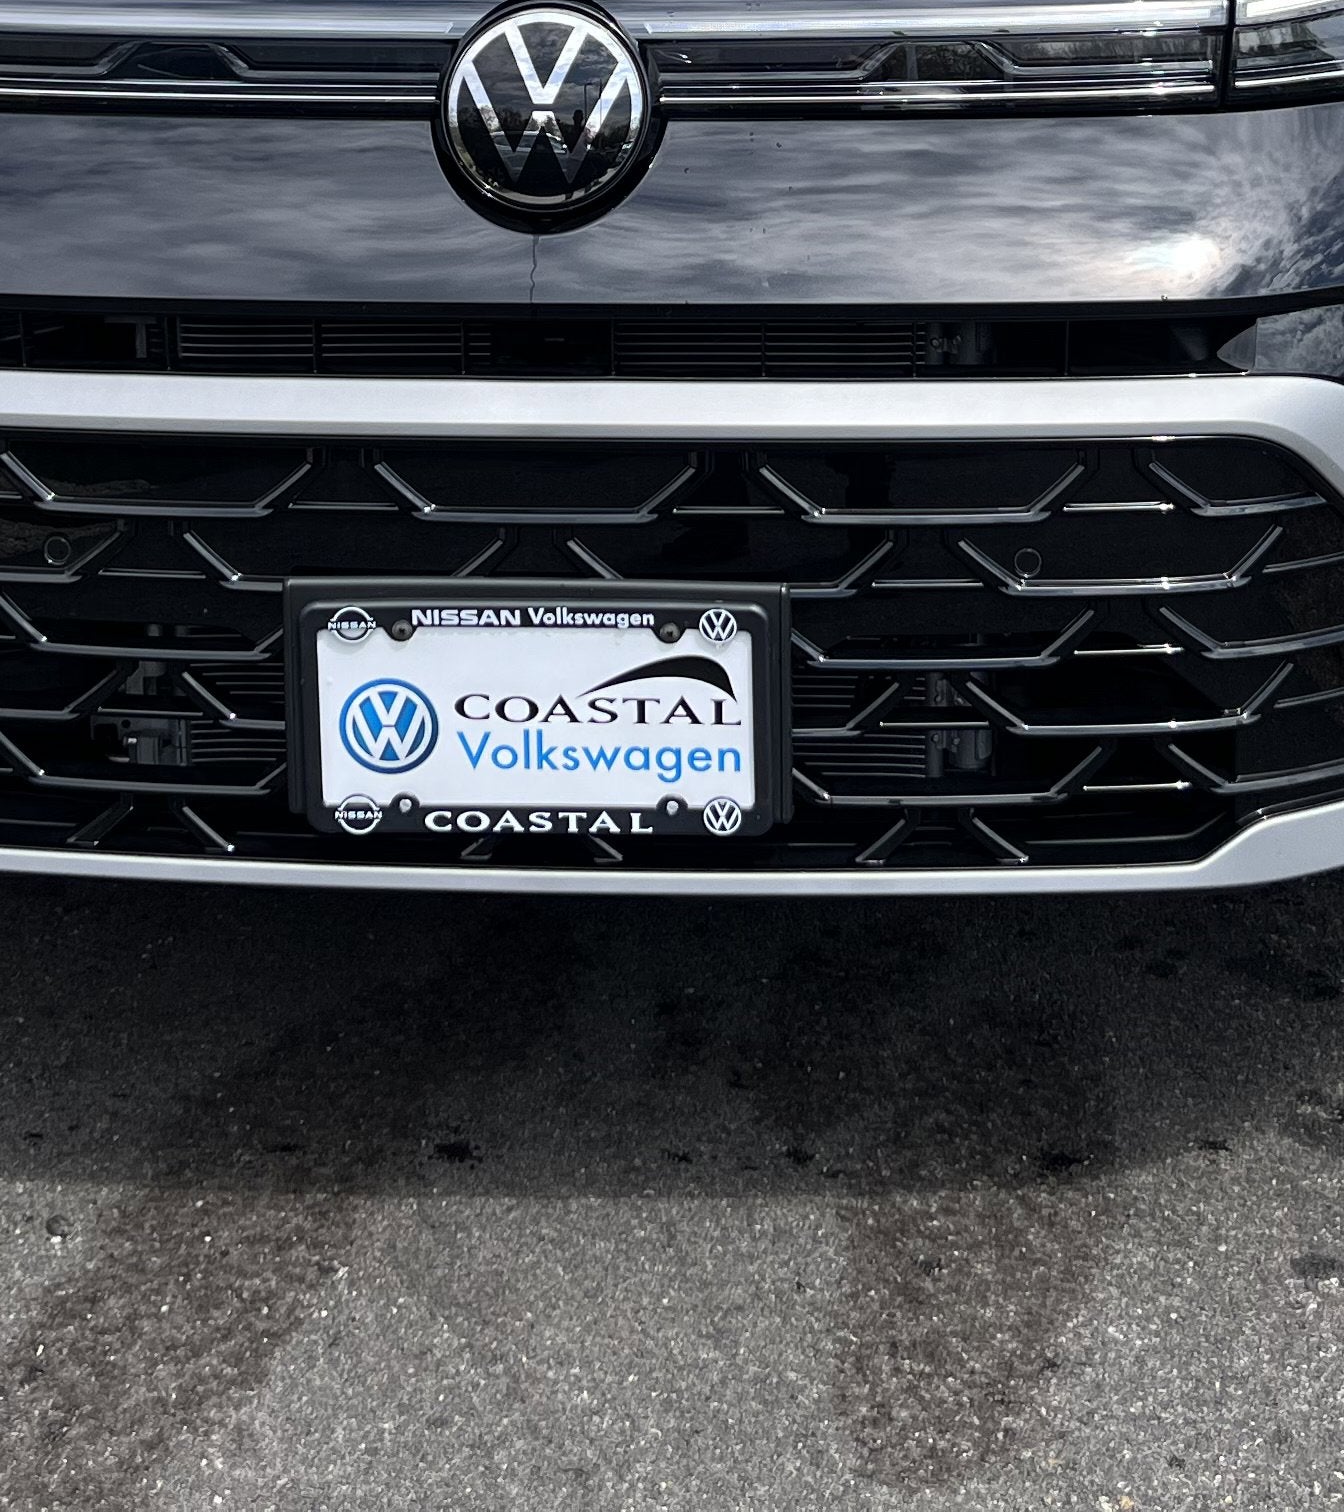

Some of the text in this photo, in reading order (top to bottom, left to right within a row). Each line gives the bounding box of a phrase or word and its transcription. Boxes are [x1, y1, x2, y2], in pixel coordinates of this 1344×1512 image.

[328, 621, 377, 630] NISSAN
[411, 606, 655, 628] NISSAN Volkswagen
[454, 693, 742, 726] COASTAL
[456, 729, 742, 783] Volkswagen
[334, 810, 383, 820] NISSAN
[424, 809, 654, 834] COASTAL
